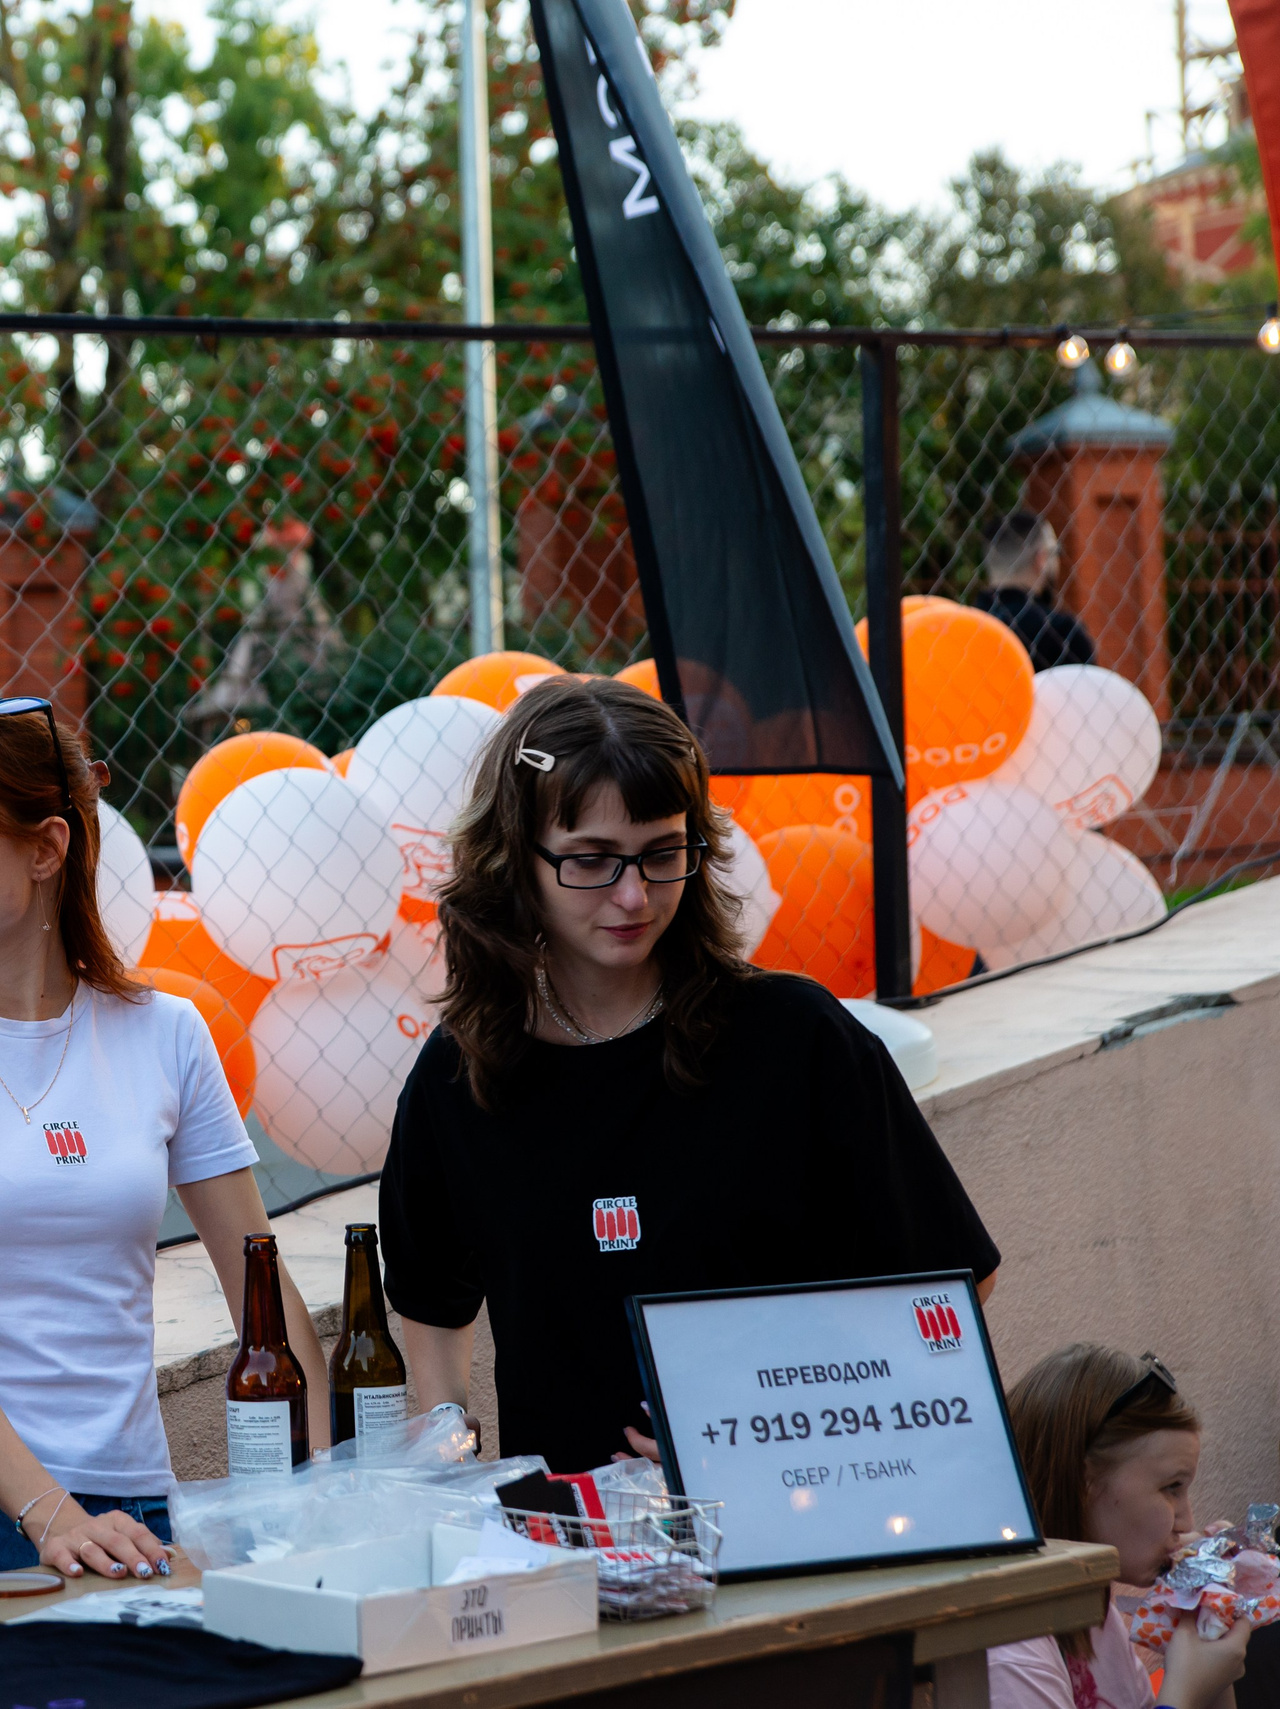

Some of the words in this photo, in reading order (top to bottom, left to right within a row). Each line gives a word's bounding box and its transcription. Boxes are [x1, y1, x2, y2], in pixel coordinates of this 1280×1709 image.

[42, 1121, 79, 1131] CIRCLE
[55, 1155, 86, 1165] PRINT
[594, 1198, 635, 1209] CIRCLE
[601, 1238, 635, 1250] PRINT
[912, 1293, 951, 1308] CIRCLE
[928, 1336, 961, 1351] PRINT
[756, 1359, 892, 1388] ПЕРЕВОДОМ
[701, 1417, 738, 1446] +7
[749, 1410, 811, 1444] 919
[820, 1404, 882, 1437] 294
[889, 1396, 973, 1430] 1602
[781, 1466, 830, 1488] СБЕР
[848, 1458, 917, 1482] Т-БАНК
[461, 1584, 489, 1611] ЭТО
[451, 1608, 504, 1642] ПРИНТЫ
